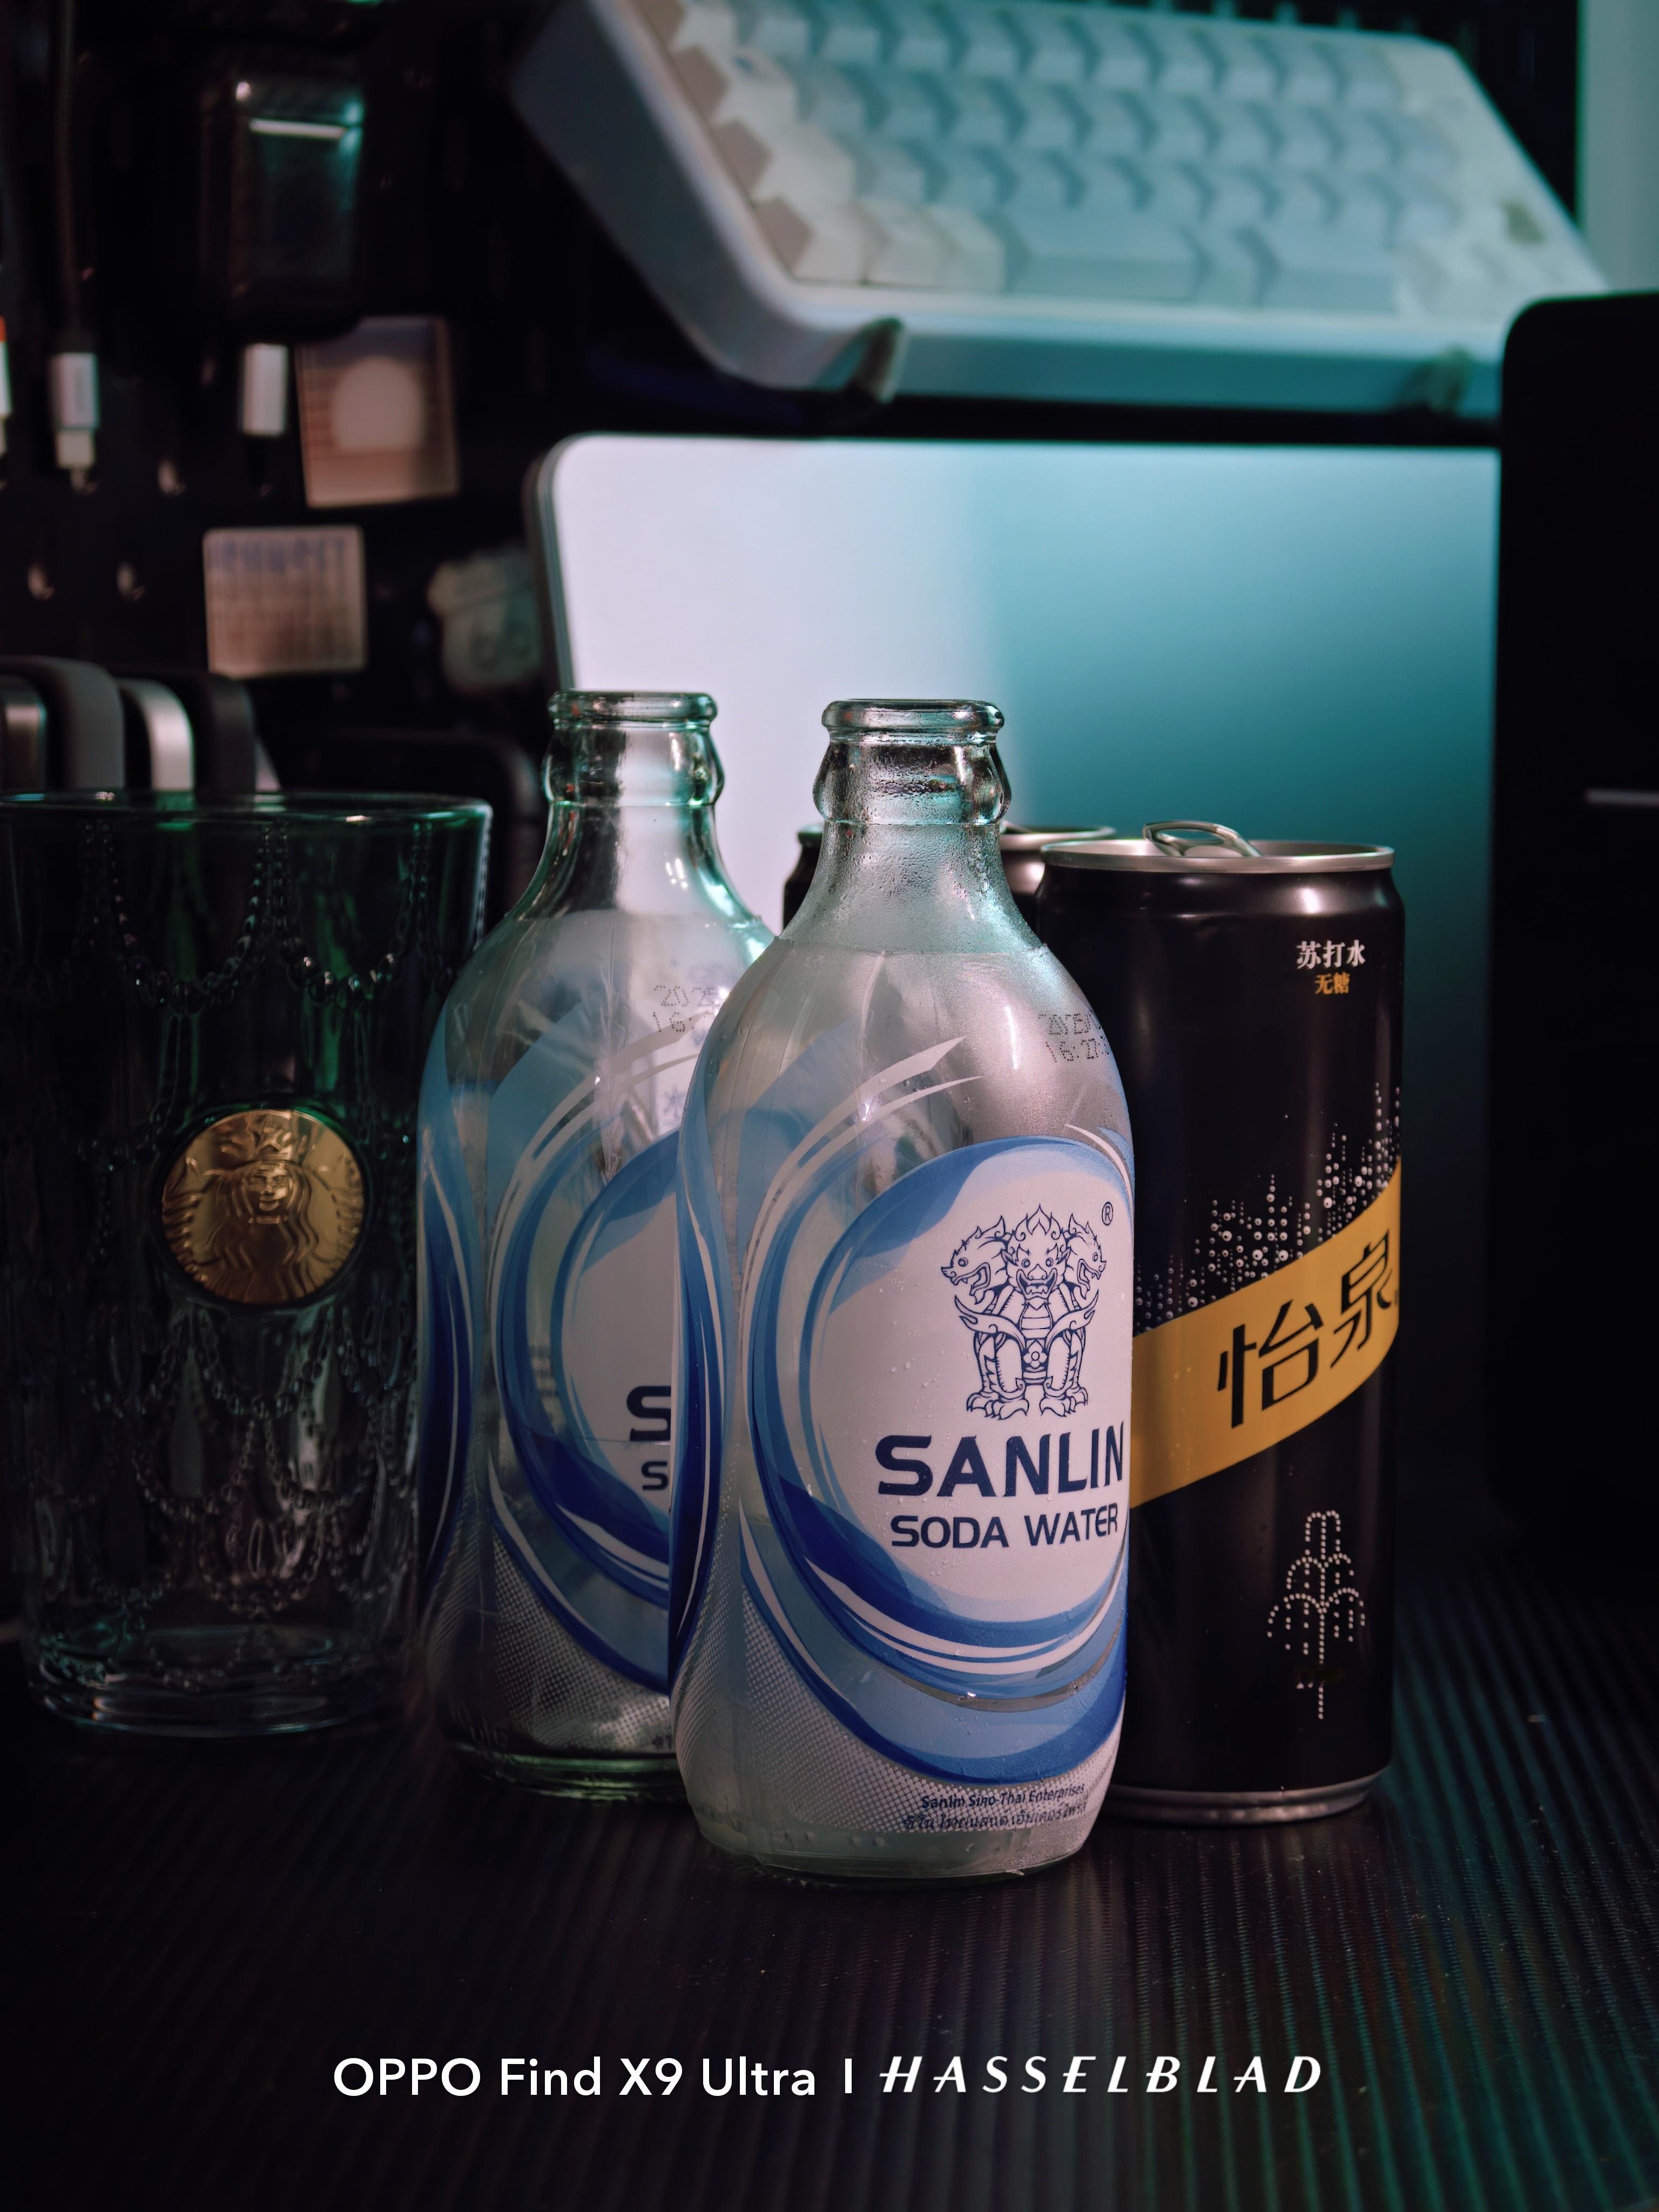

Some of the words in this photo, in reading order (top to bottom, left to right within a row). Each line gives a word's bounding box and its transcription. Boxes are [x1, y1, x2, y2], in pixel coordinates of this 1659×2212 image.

[1297, 939, 1366, 969] 苏打水
[1314, 972, 1351, 995] 无糖
[1217, 1229, 1393, 1429] 怡泉
[875, 1420, 1124, 1498] SANLIN
[891, 1515, 1009, 1549] SODA
[1024, 1502, 1119, 1546] WATER
[921, 1794, 965, 1809] Sanlin
[1028, 1784, 1085, 1803] Enterprises
